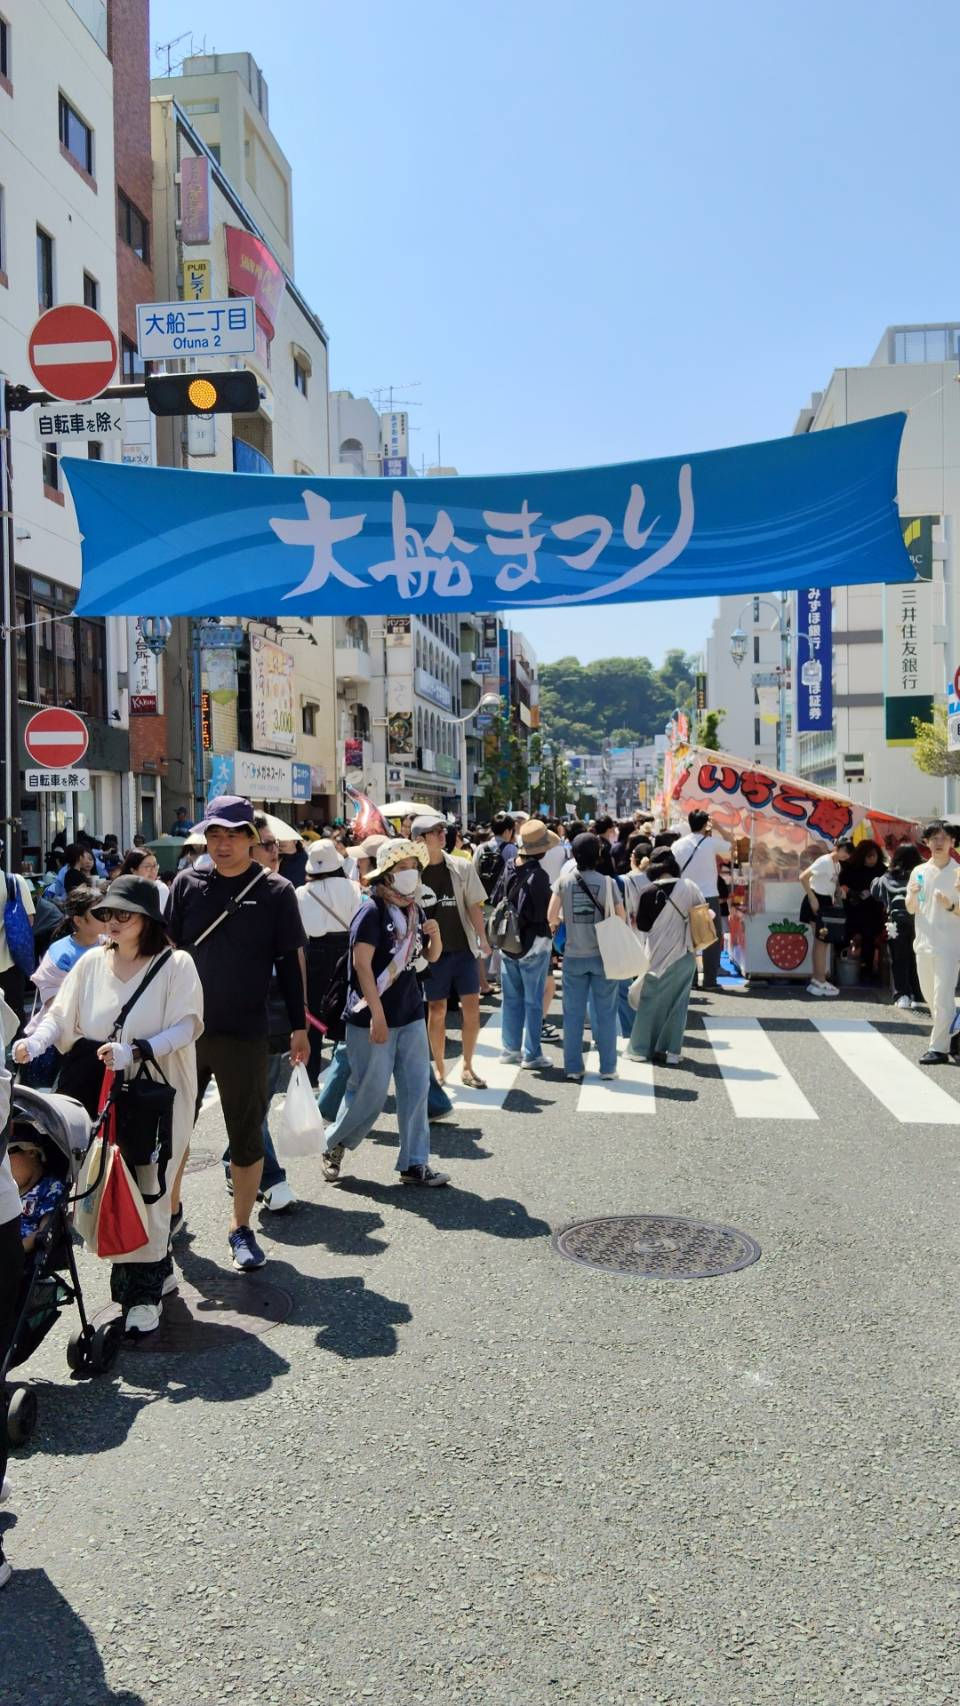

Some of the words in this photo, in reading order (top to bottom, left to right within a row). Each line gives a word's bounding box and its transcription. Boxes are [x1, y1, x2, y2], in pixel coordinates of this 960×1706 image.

[187, 264, 207, 272] PUB
[146, 307, 247, 336] 大船二丁目
[173, 337, 209, 350] Ofuna
[214, 336, 222, 348] 2
[39, 412, 123, 435] 自転車を除く
[269, 464, 694, 605] 大船まつり
[901, 589, 918, 690] 三井住友銀行
[29, 773, 87, 788] 自転車を除く
